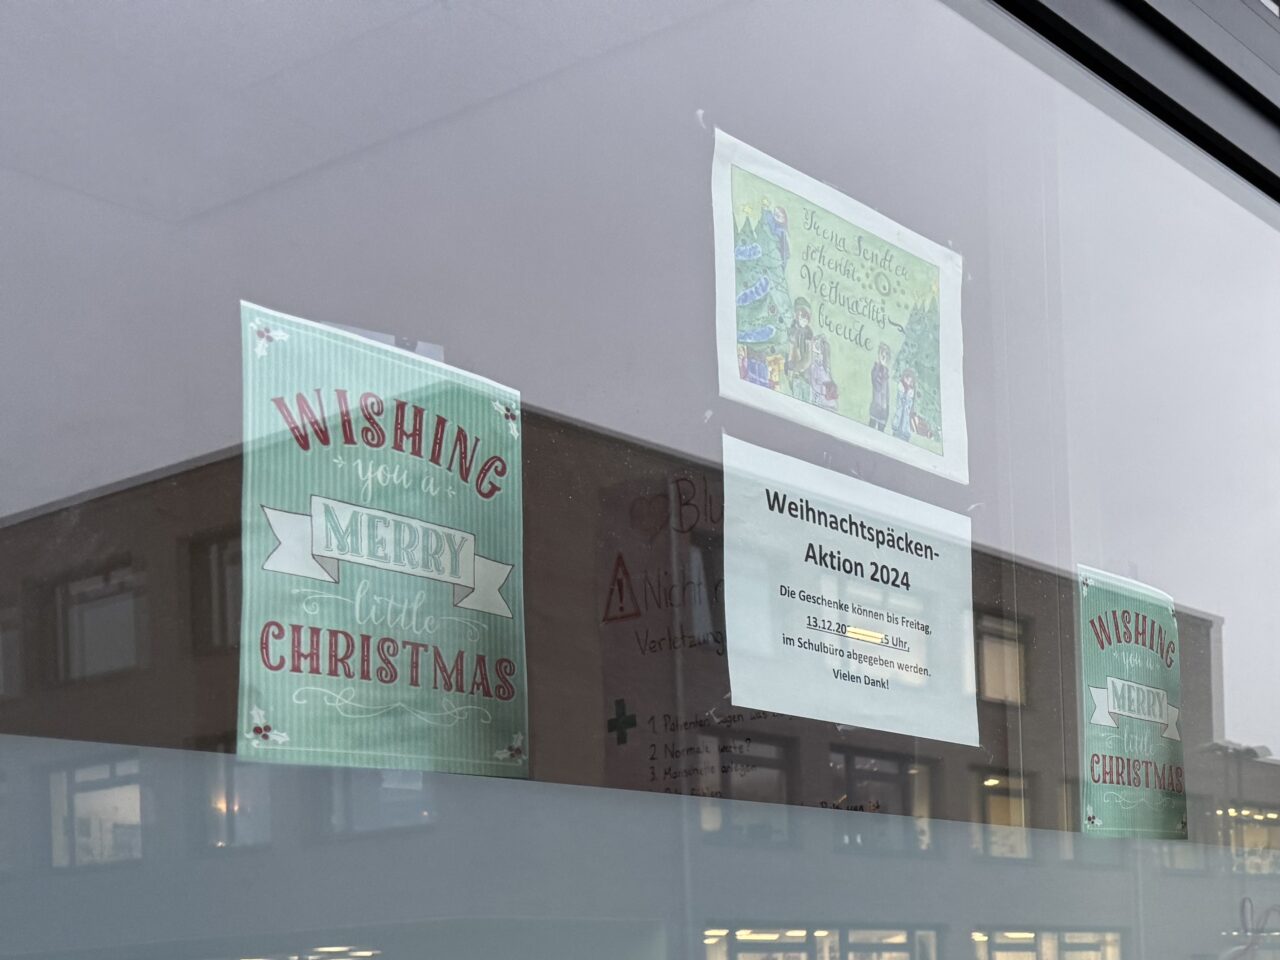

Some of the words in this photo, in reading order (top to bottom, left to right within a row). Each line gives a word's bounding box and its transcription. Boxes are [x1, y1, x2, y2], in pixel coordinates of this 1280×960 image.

[802, 244, 856, 282] schenkt
[854, 234, 909, 281] Sendler
[271, 387, 508, 501] WISHING
[352, 458, 412, 504] you
[420, 474, 440, 497] a
[671, 475, 724, 534] Blu
[322, 501, 469, 580] MERRY
[765, 488, 940, 561] Weihnachtspäcken-
[804, 542, 865, 578] Aktion
[869, 561, 911, 591] 2024
[354, 579, 441, 634] little
[780, 585, 796, 598] Die
[798, 590, 849, 612] Geschenke
[851, 603, 884, 621] können
[886, 612, 899, 625] bis
[901, 616, 932, 635] Freitag,
[782, 633, 795, 647] im
[797, 637, 845, 658] Schulbüro
[846, 649, 895, 670] abgegeben
[896, 661, 932, 677] werden.
[806, 615, 852, 636] 13.12.20
[892, 636, 910, 653] Uhr,
[1089, 609, 1176, 669] WISHING
[260, 620, 517, 702] CHRISTMAS
[832, 668, 862, 684] Vielen
[864, 675, 889, 690] Dank!
[1110, 679, 1166, 721] MERRY
[1090, 752, 1186, 795] CHRISTMAS
